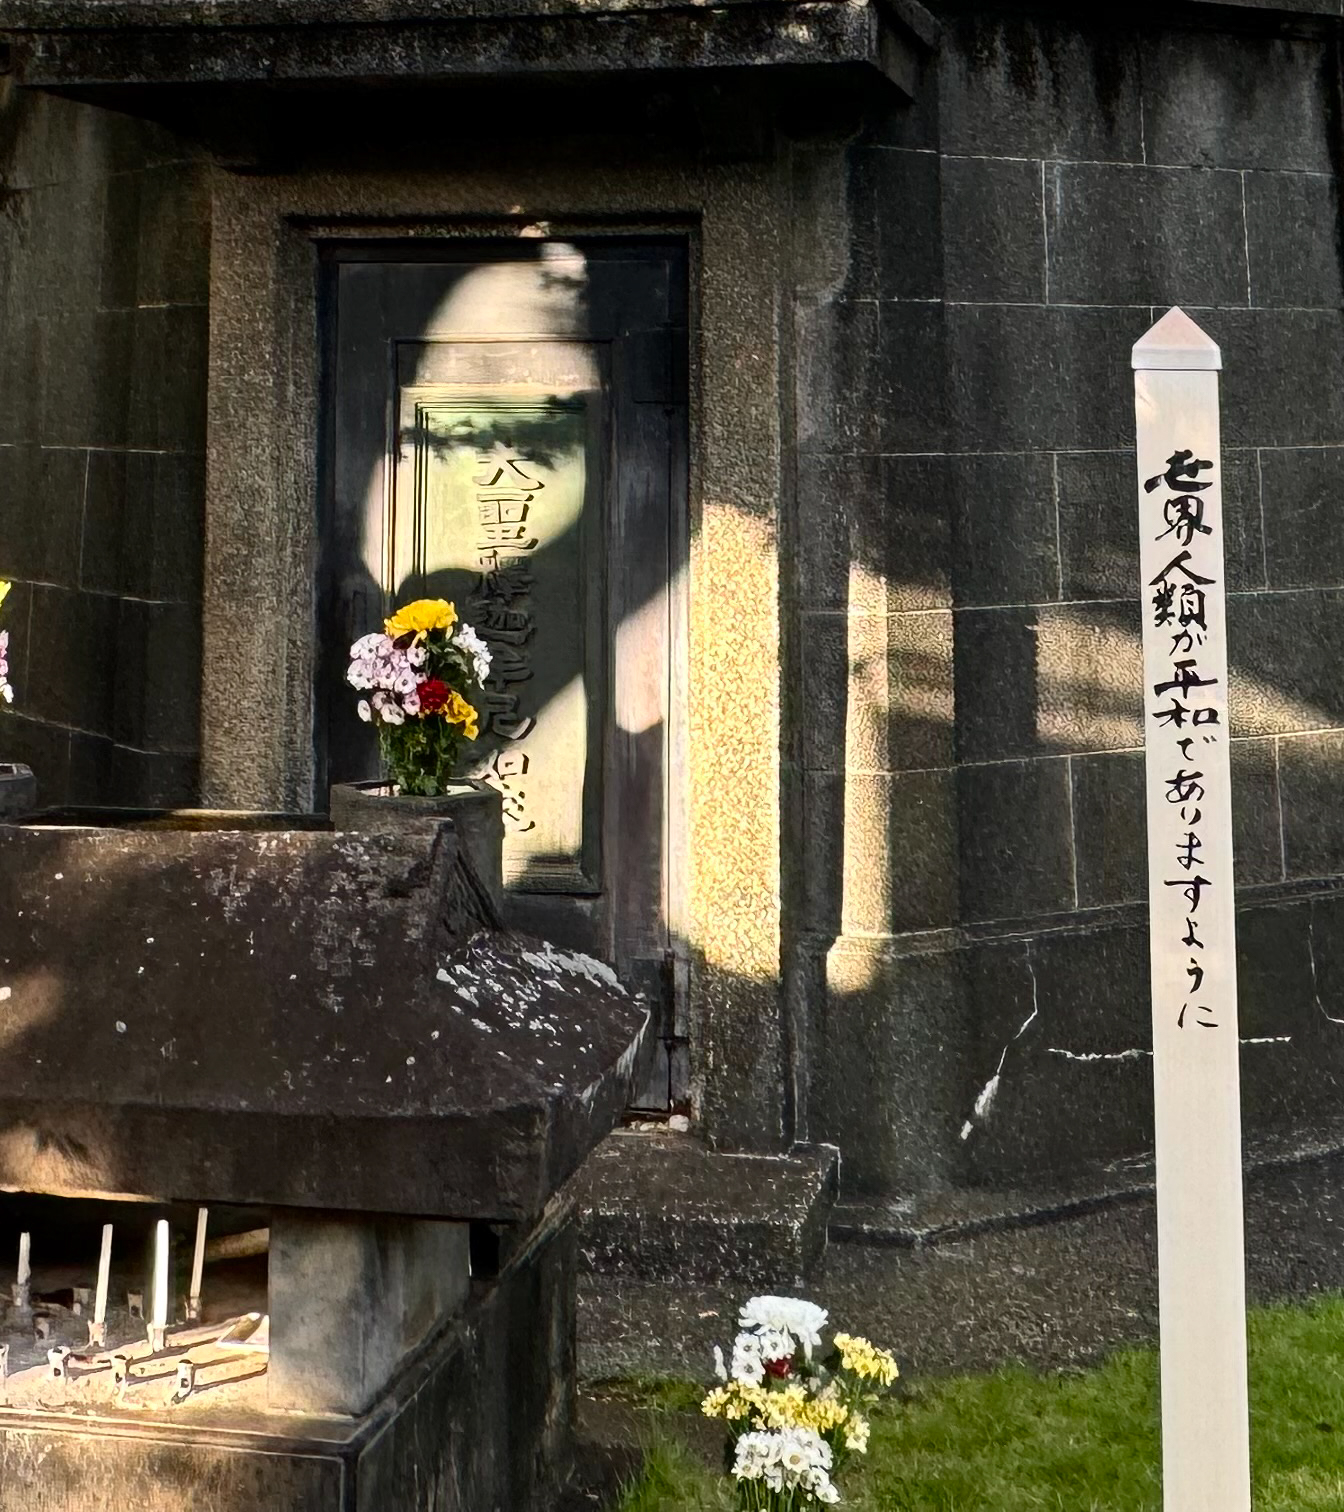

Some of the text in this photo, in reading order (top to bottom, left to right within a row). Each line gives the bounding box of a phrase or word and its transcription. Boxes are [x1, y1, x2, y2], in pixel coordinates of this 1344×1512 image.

[1143, 449, 1220, 1030] 世界人類が平和でありますように
